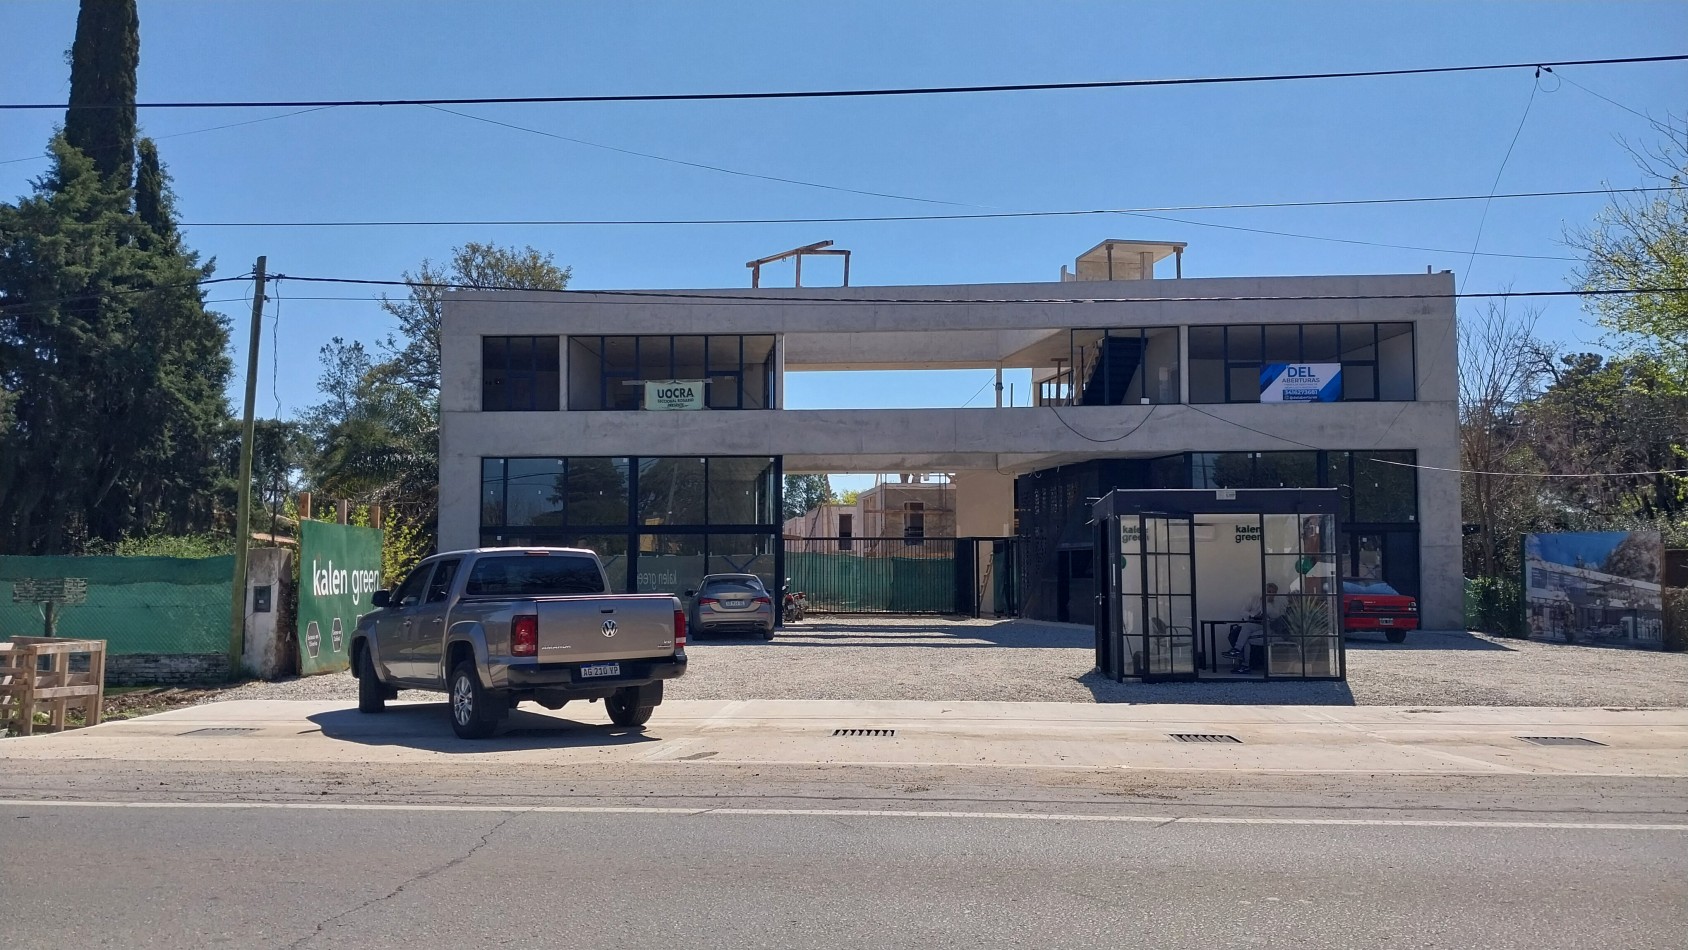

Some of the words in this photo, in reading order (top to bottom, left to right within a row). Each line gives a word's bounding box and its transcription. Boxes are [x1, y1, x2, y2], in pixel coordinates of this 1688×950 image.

[1287, 366, 1316, 378] DEL
[657, 387, 695, 399] UOCRA
[312, 559, 348, 596] kalen
[351, 568, 379, 606] green
